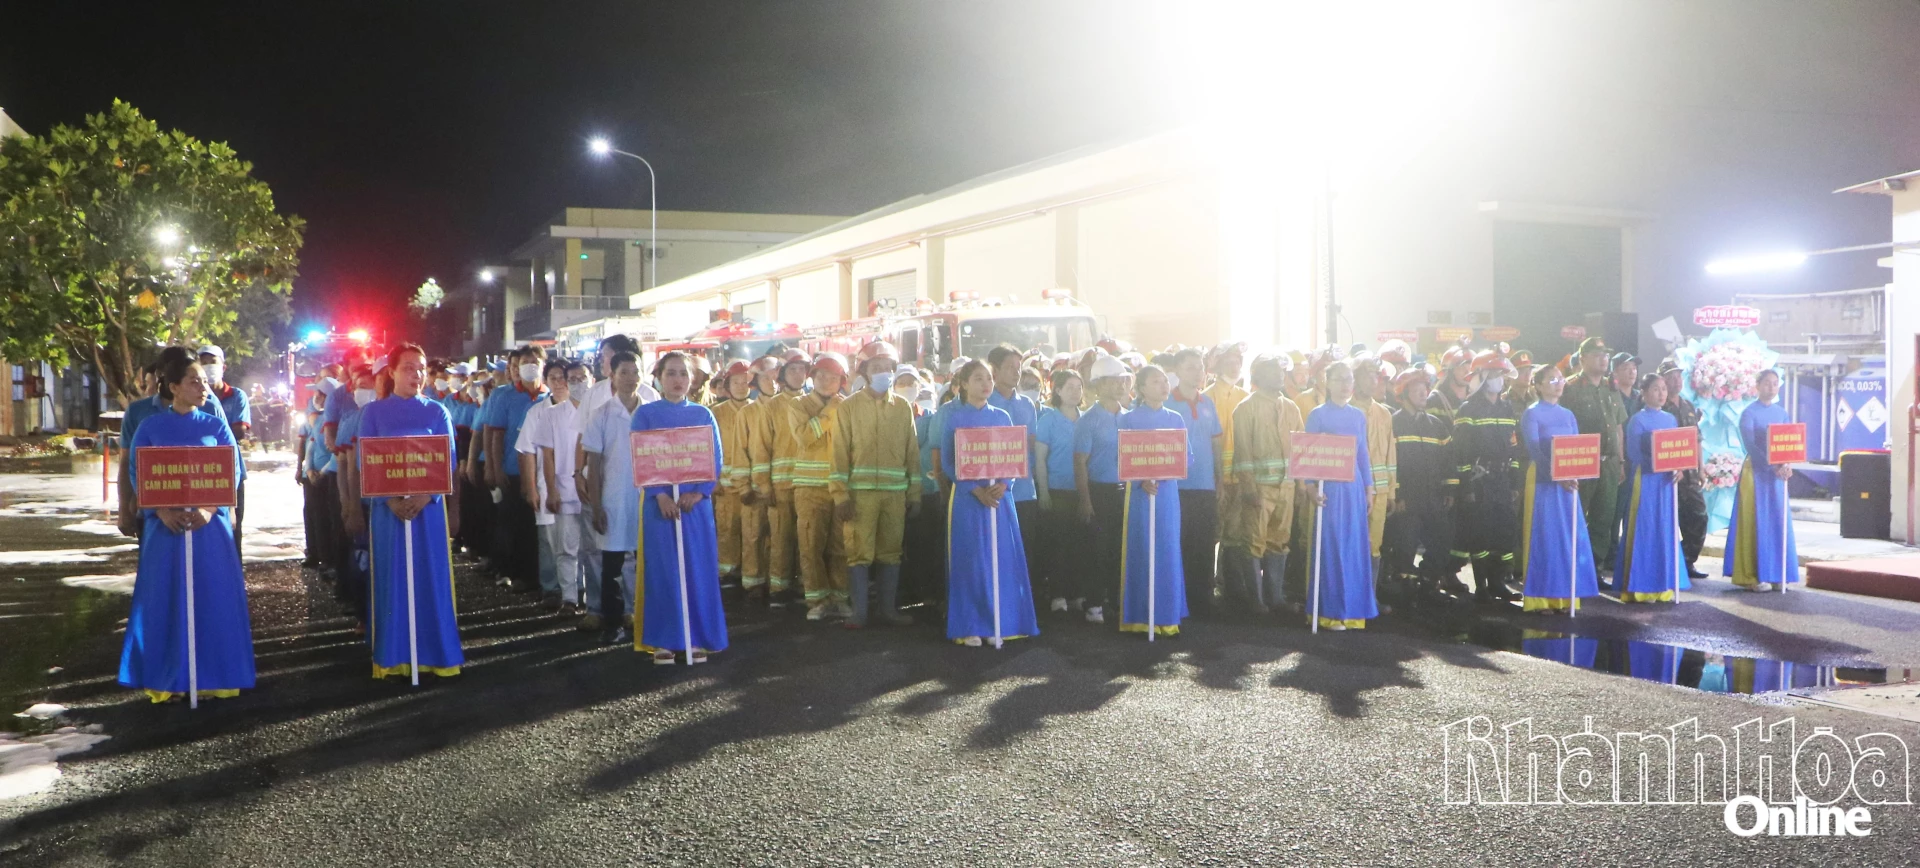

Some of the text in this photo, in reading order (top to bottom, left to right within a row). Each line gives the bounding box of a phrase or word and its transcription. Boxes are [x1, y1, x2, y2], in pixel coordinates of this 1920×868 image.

[385, 454, 393, 463] TY
[972, 455, 988, 464] NAM
[989, 455, 1004, 464] CAM
[1006, 454, 1024, 463] RANH
[1670, 450, 1681, 458] CAM
[655, 457, 692, 469] CAM RANH
[151, 462, 165, 476] ĐỘI
[167, 462, 189, 475] QUẢN
[203, 462, 222, 475] ĐIỆN
[386, 467, 427, 478] CAM RANH
[144, 480, 161, 490] CAM
[162, 479, 181, 489] RANH
[190, 477, 214, 489] KHÁNH
[215, 477, 229, 488] SƠN
